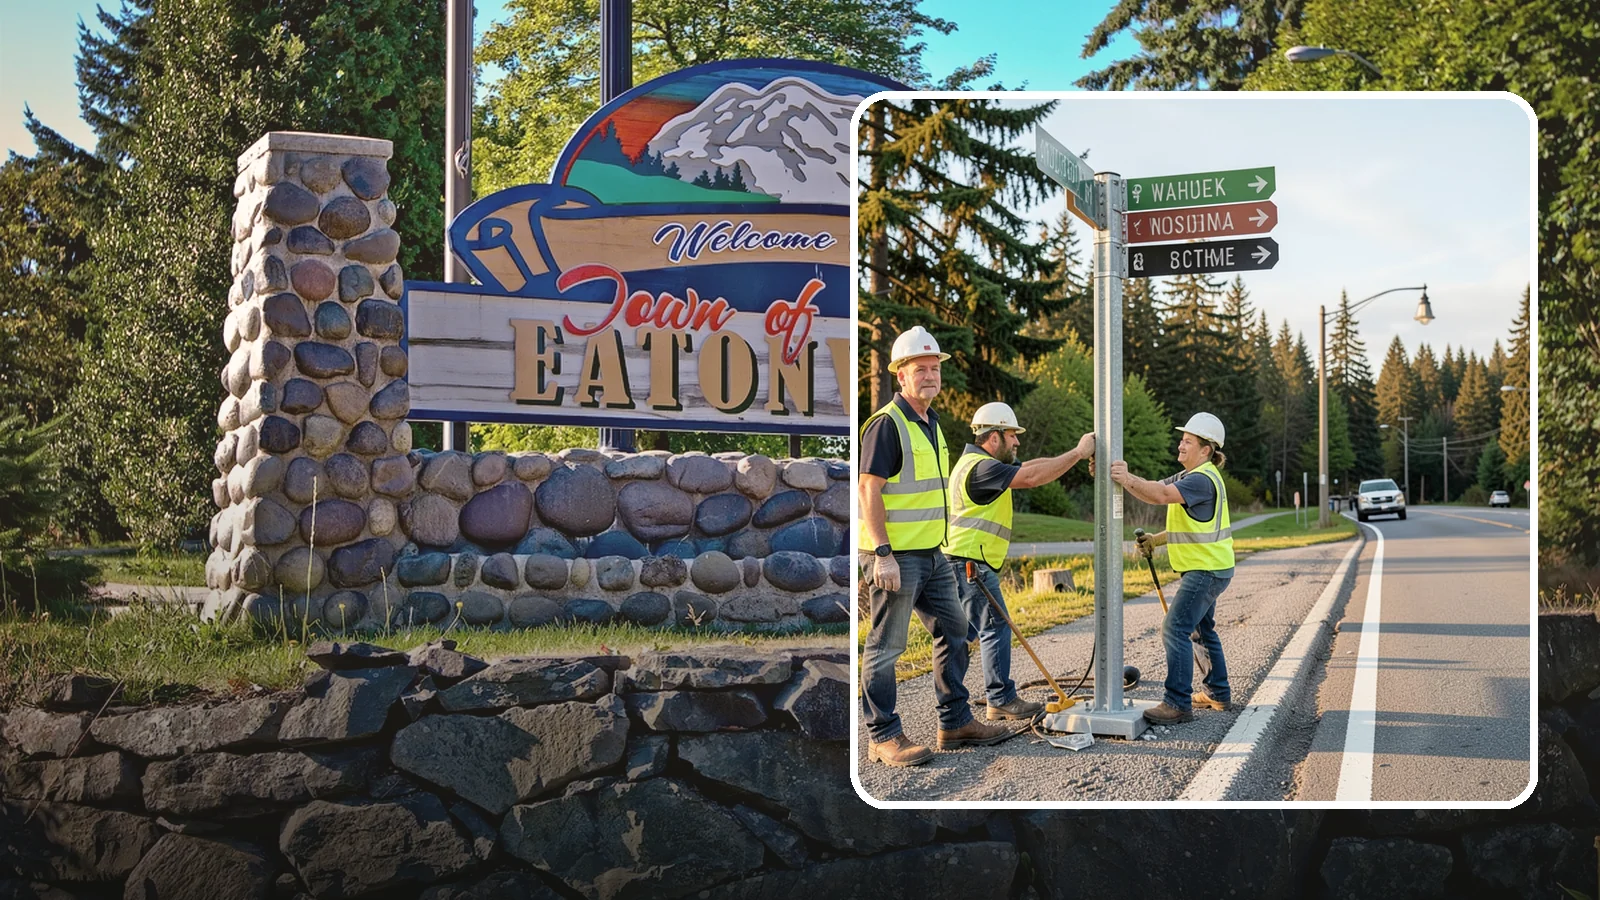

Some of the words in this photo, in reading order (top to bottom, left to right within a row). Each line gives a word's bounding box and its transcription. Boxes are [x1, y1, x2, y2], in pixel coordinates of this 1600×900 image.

[653, 220, 837, 263] Welcome
[556, 262, 736, 337] Town
[765, 278, 826, 365] of
